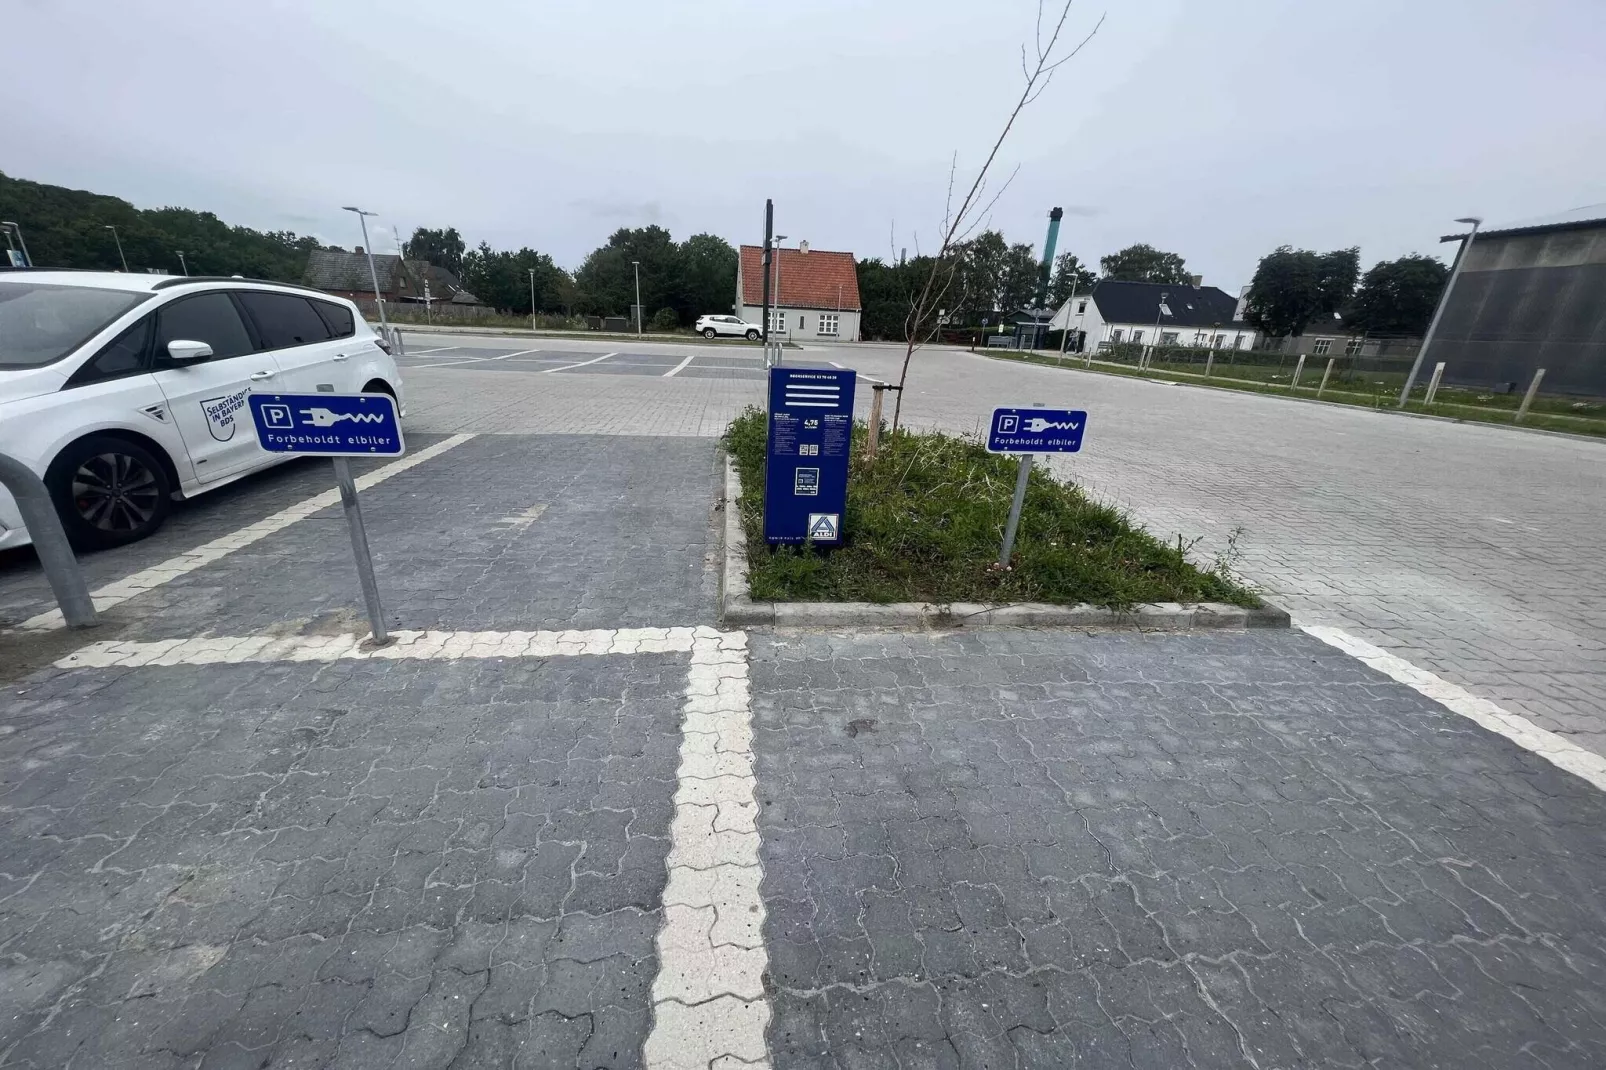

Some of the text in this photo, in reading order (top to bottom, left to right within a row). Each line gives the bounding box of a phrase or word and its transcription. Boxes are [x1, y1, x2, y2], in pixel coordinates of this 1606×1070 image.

[212, 413, 221, 423] IN
[220, 415, 234, 427] BDS
[270, 409, 284, 424] P
[1004, 419, 1014, 430] P
[268, 434, 391, 445] Forbeholdt elbiler
[994, 437, 1076, 446] Forbeholdt elbiler
